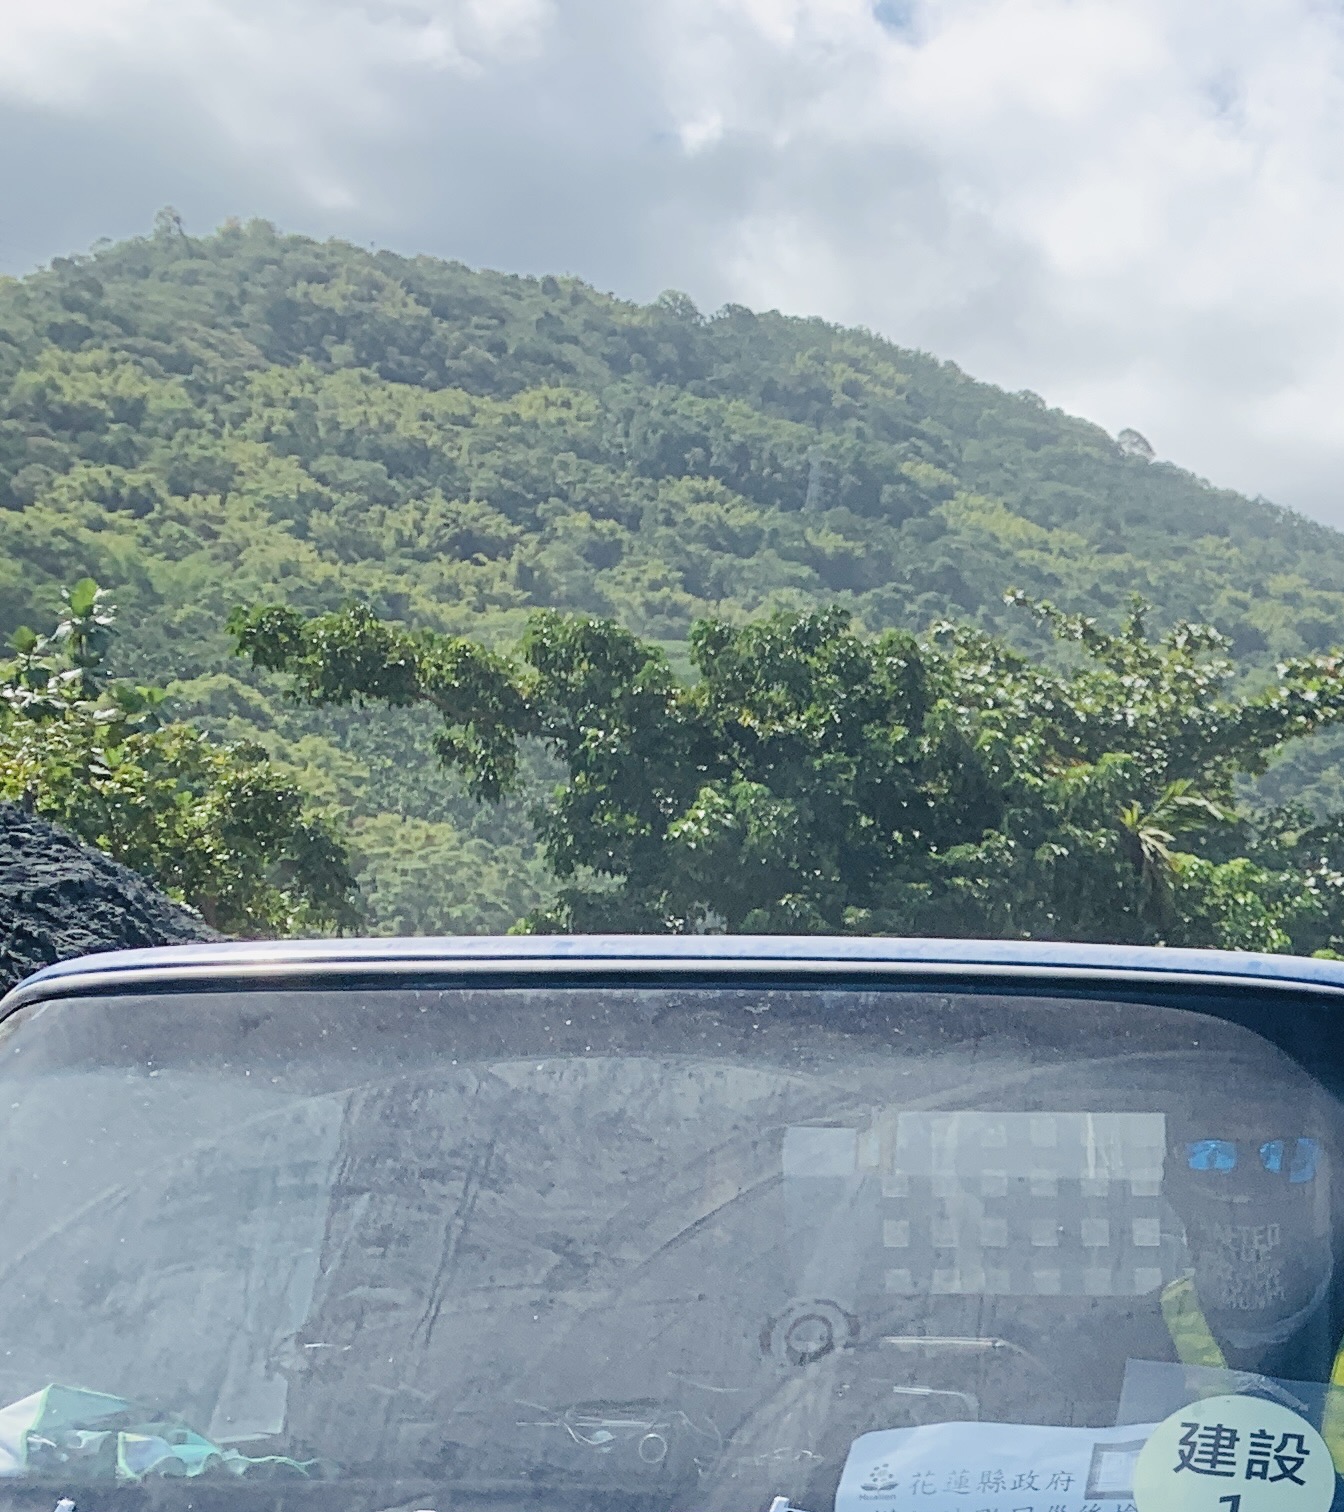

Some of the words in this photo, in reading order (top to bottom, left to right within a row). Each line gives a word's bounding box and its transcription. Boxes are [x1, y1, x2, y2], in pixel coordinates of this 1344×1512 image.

[1172, 1421, 1310, 1486] 建設
[911, 1470, 1076, 1496] 花蓮縣政府
